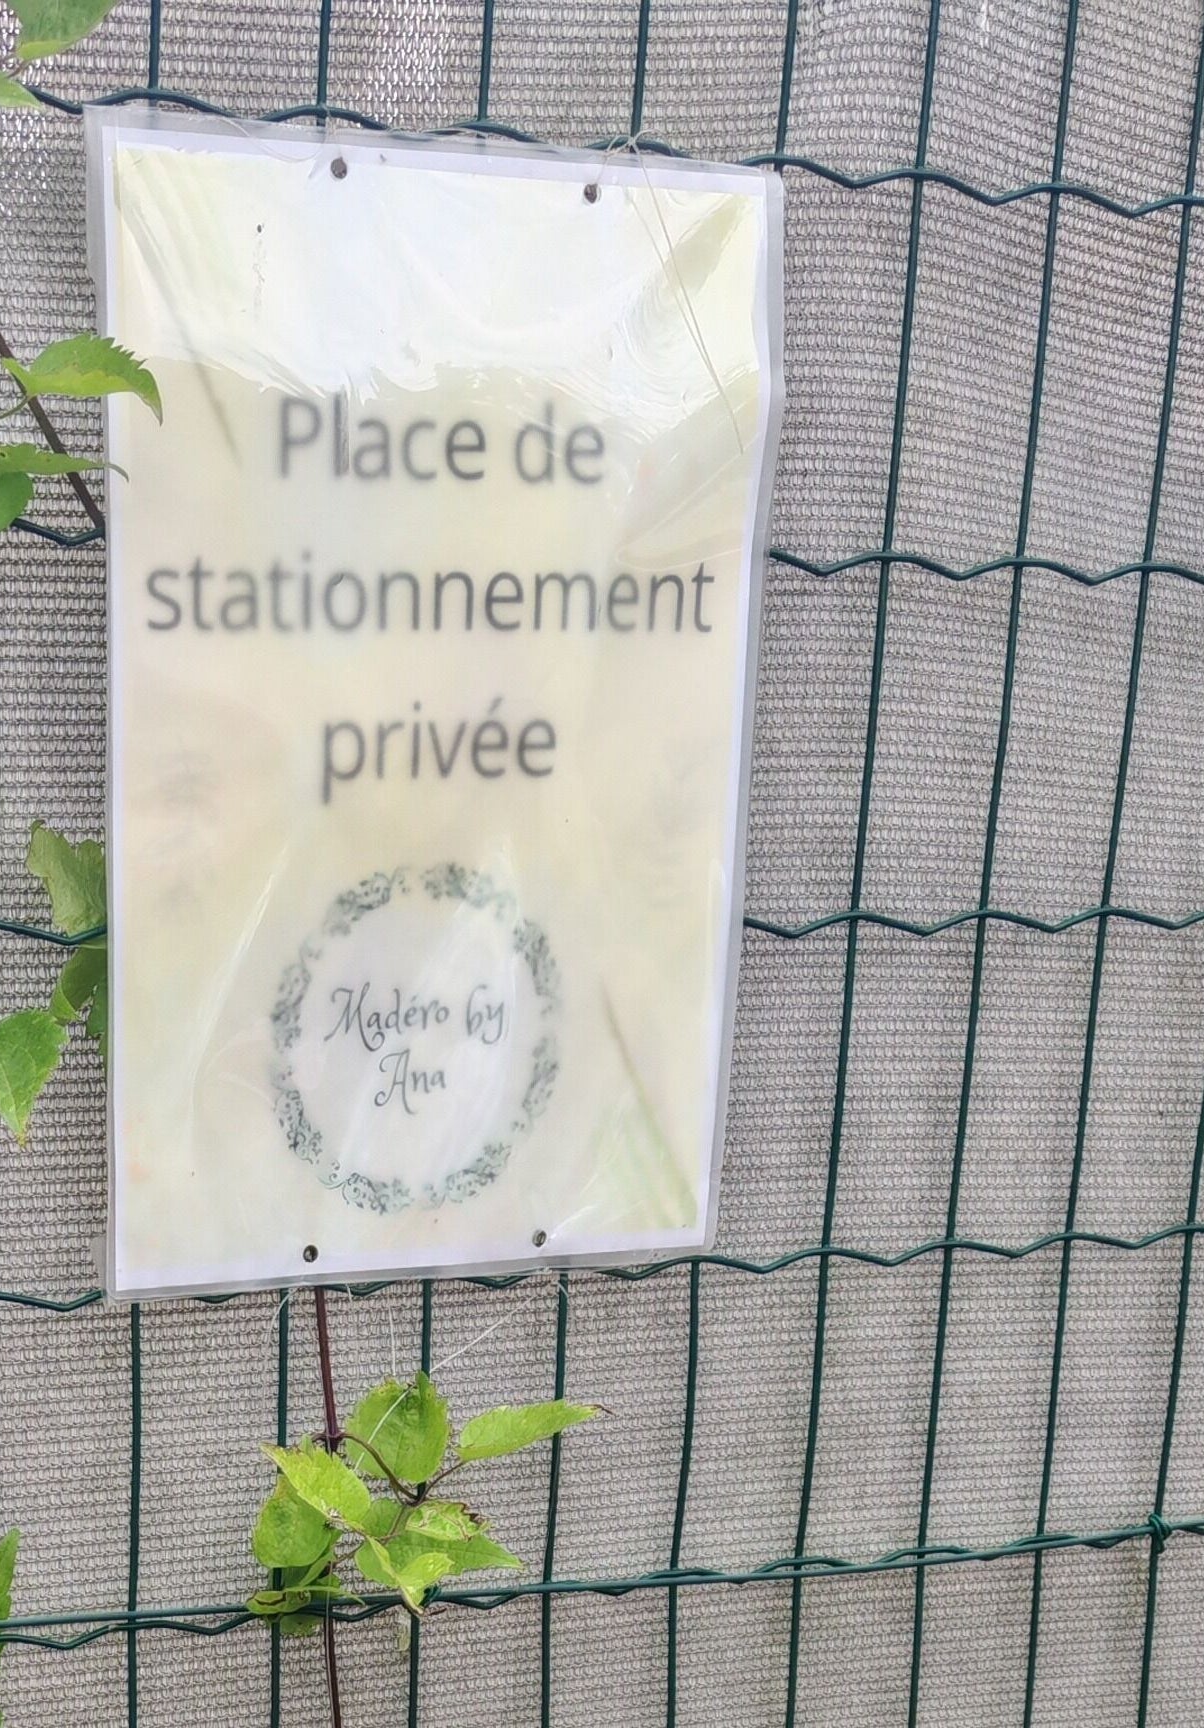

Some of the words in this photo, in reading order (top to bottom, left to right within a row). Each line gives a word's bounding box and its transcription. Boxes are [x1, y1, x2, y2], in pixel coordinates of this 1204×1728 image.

[277, 392, 486, 482] Place
[513, 402, 607, 484] de
[144, 549, 715, 635] stationnement
[321, 698, 557, 805] privée
[466, 984, 504, 1044] by
[374, 1049, 446, 1115] Ana
